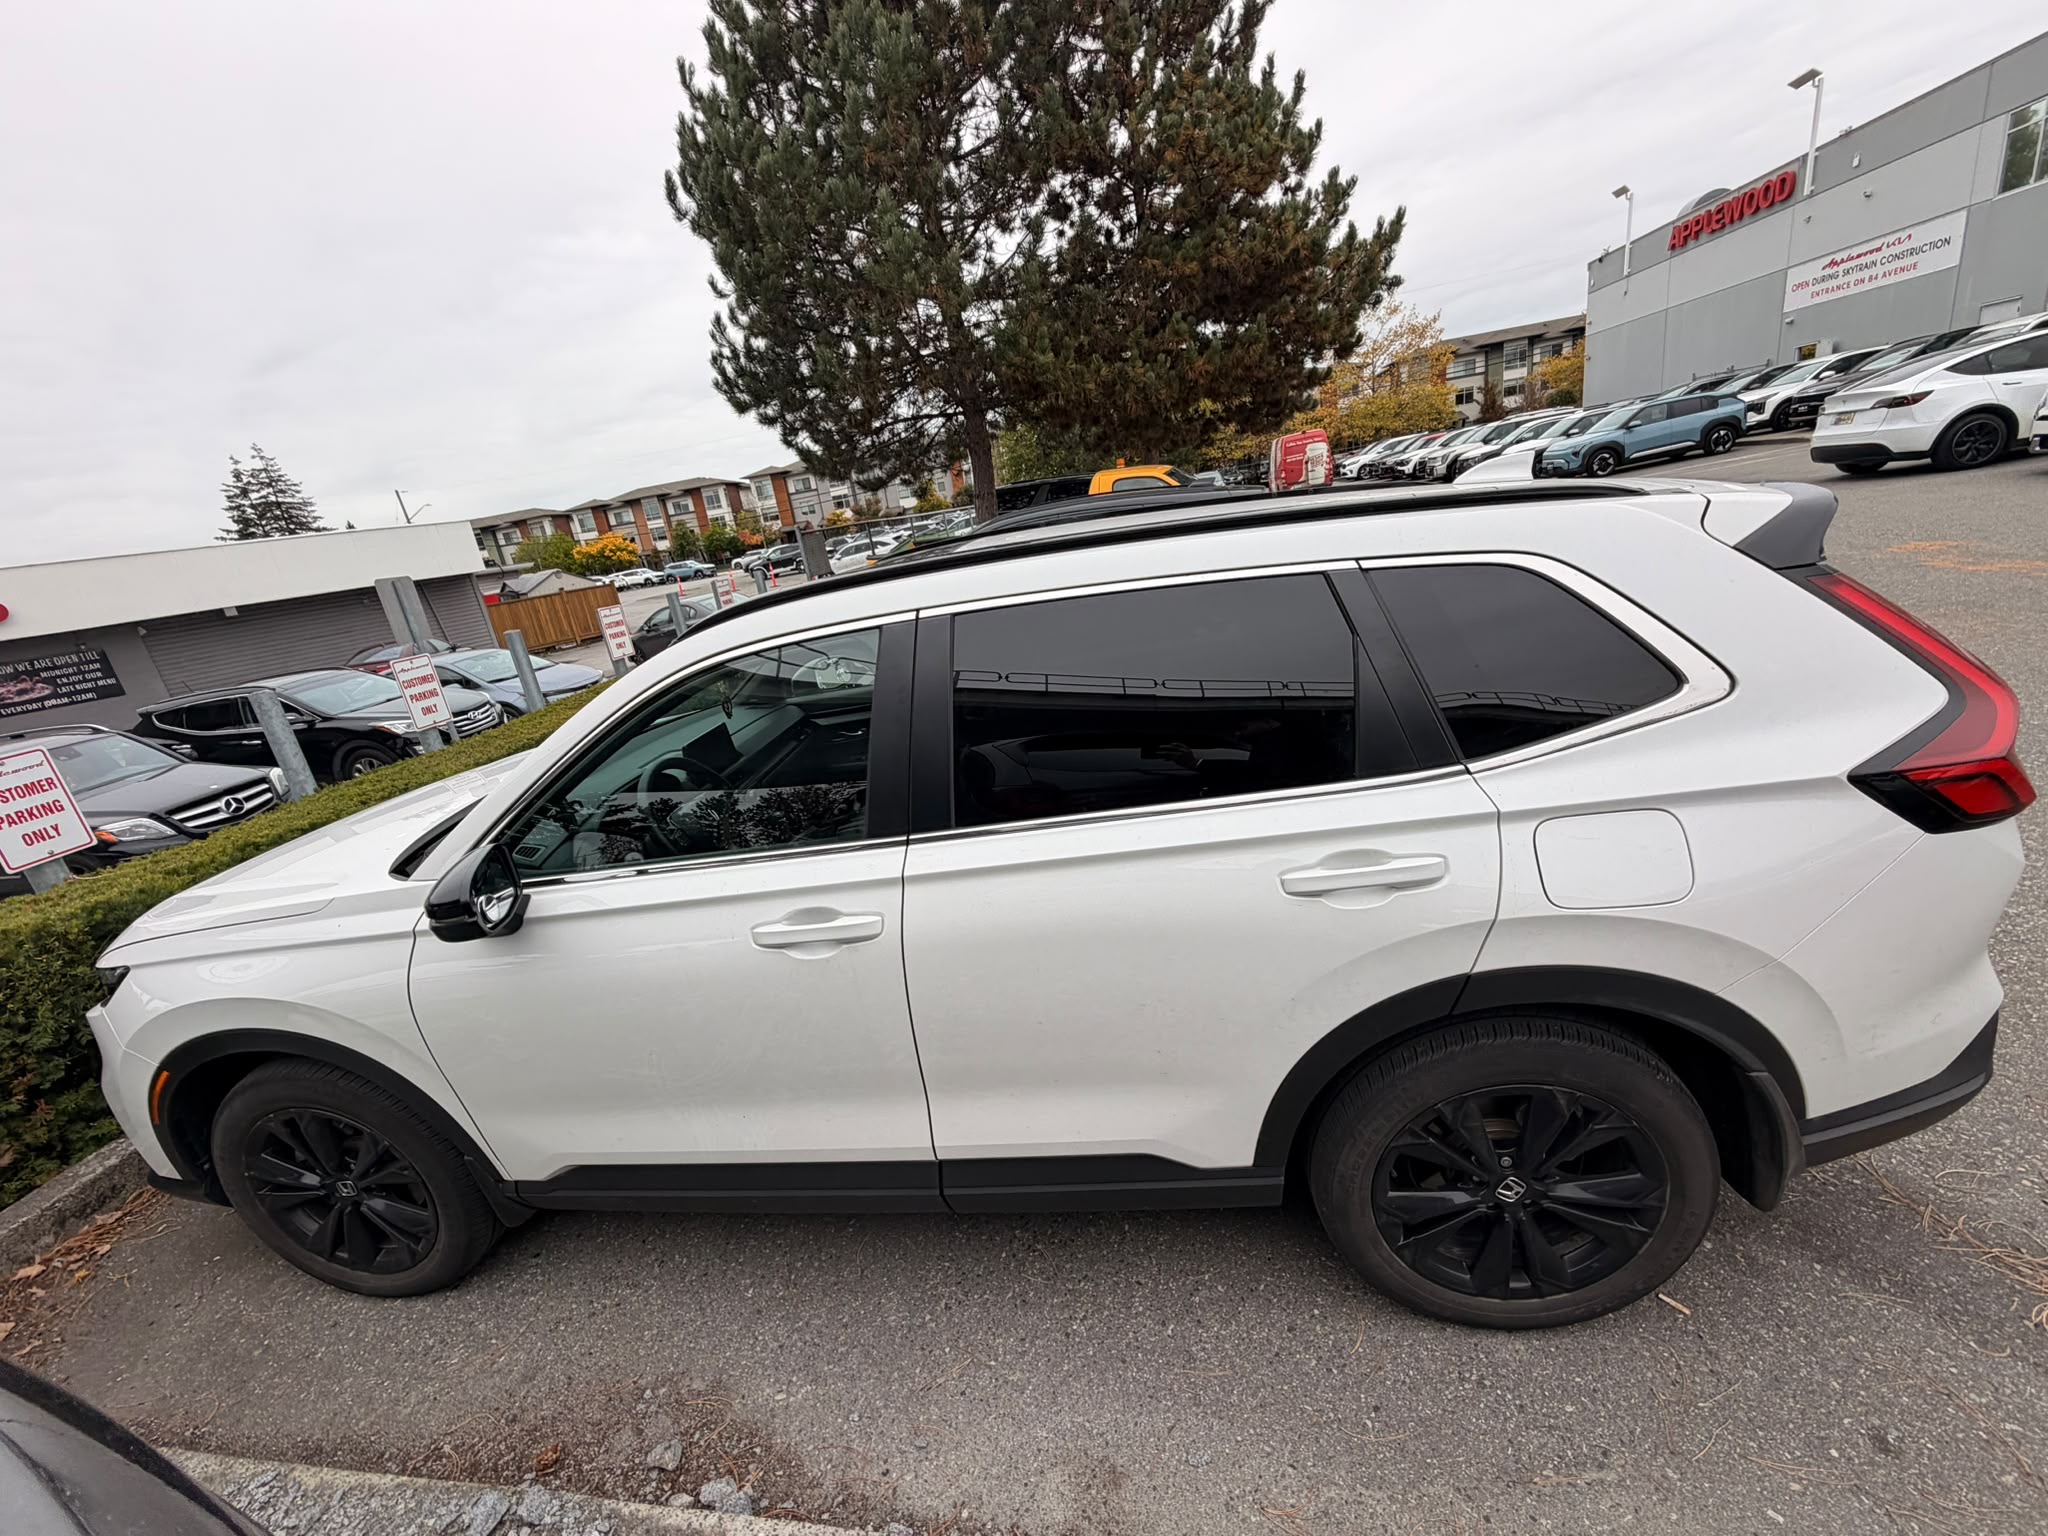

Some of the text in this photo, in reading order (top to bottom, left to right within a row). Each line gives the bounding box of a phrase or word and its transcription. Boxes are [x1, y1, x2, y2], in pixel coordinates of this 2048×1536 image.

[1667, 170, 1797, 251] APPLEWOOD
[1791, 236, 1952, 293] OPEN DURING SKYTRAIN CONSTRUCTION
[1822, 241, 1885, 271] Applewood
[1810, 282, 1851, 299] ENTRANCE
[1853, 277, 1866, 287] ON
[1881, 261, 1919, 280] AVENUE
[15, 661, 33, 672] WE
[33, 657, 53, 670] ARE
[53, 653, 79, 667] OPEN
[79, 650, 100, 661] TILL
[40, 662, 102, 678] MIDNIGHT 12AM
[56, 671, 103, 685] ENJOY OUR
[57, 684, 75, 694] LATE
[75, 681, 97, 691] NIGHT
[402, 673, 436, 690] CUSTOMER
[409, 688, 440, 704] PARKING
[0, 701, 42, 715] EVERYDAY
[421, 703, 439, 717] ONLY
[21, 823, 62, 847] ONLY
